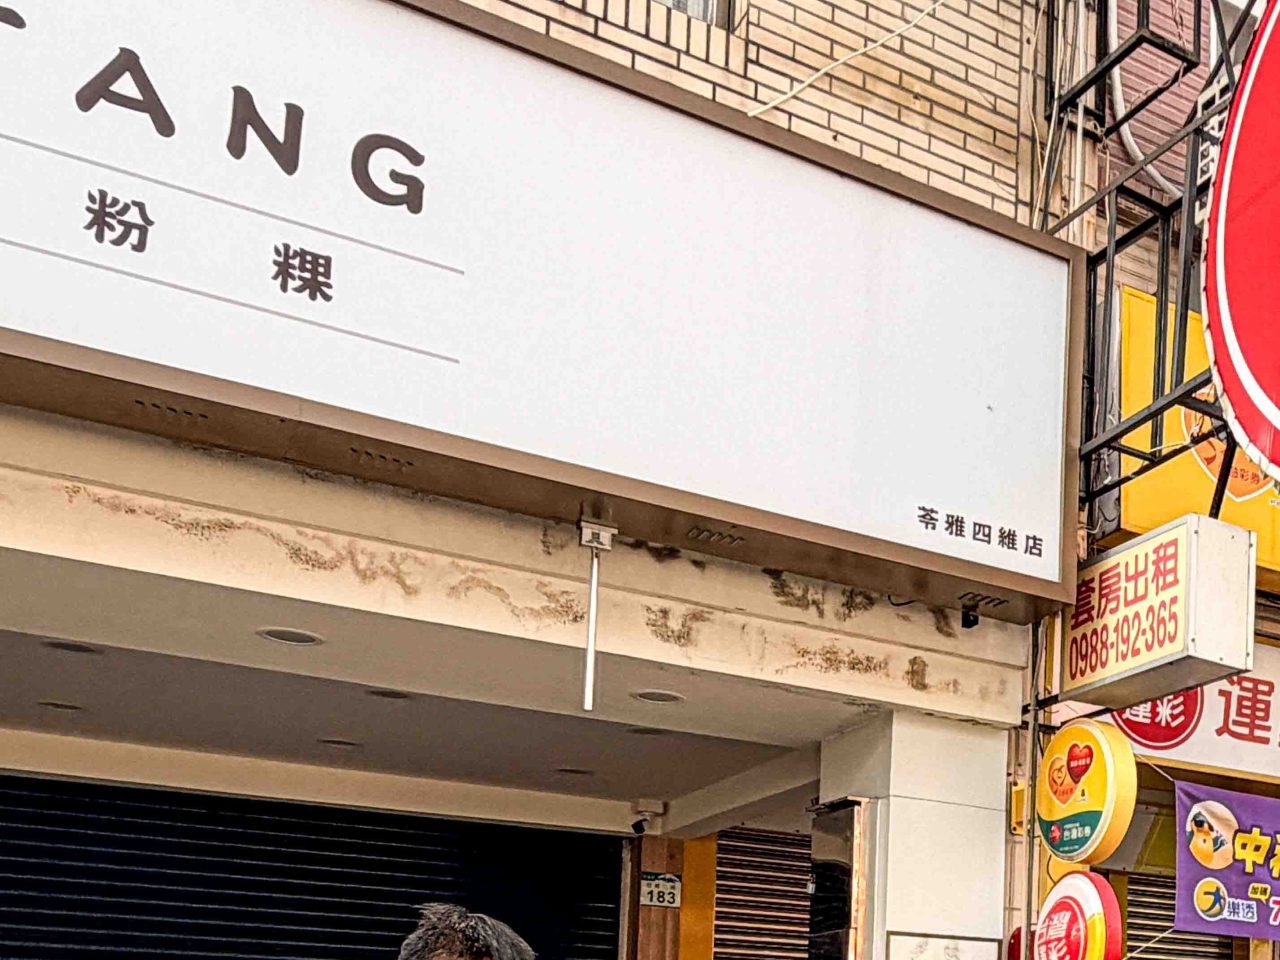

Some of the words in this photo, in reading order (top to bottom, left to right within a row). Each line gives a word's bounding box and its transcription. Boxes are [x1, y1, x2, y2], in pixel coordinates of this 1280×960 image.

[0, 5, 426, 214] ANG
[83, 189, 334, 302] 粉粿
[917, 506, 1044, 558] 苓雅四維店
[1070, 538, 1180, 631] 套房出租
[1069, 596, 1179, 681] 0988-192-365
[647, 889, 676, 904] 183
